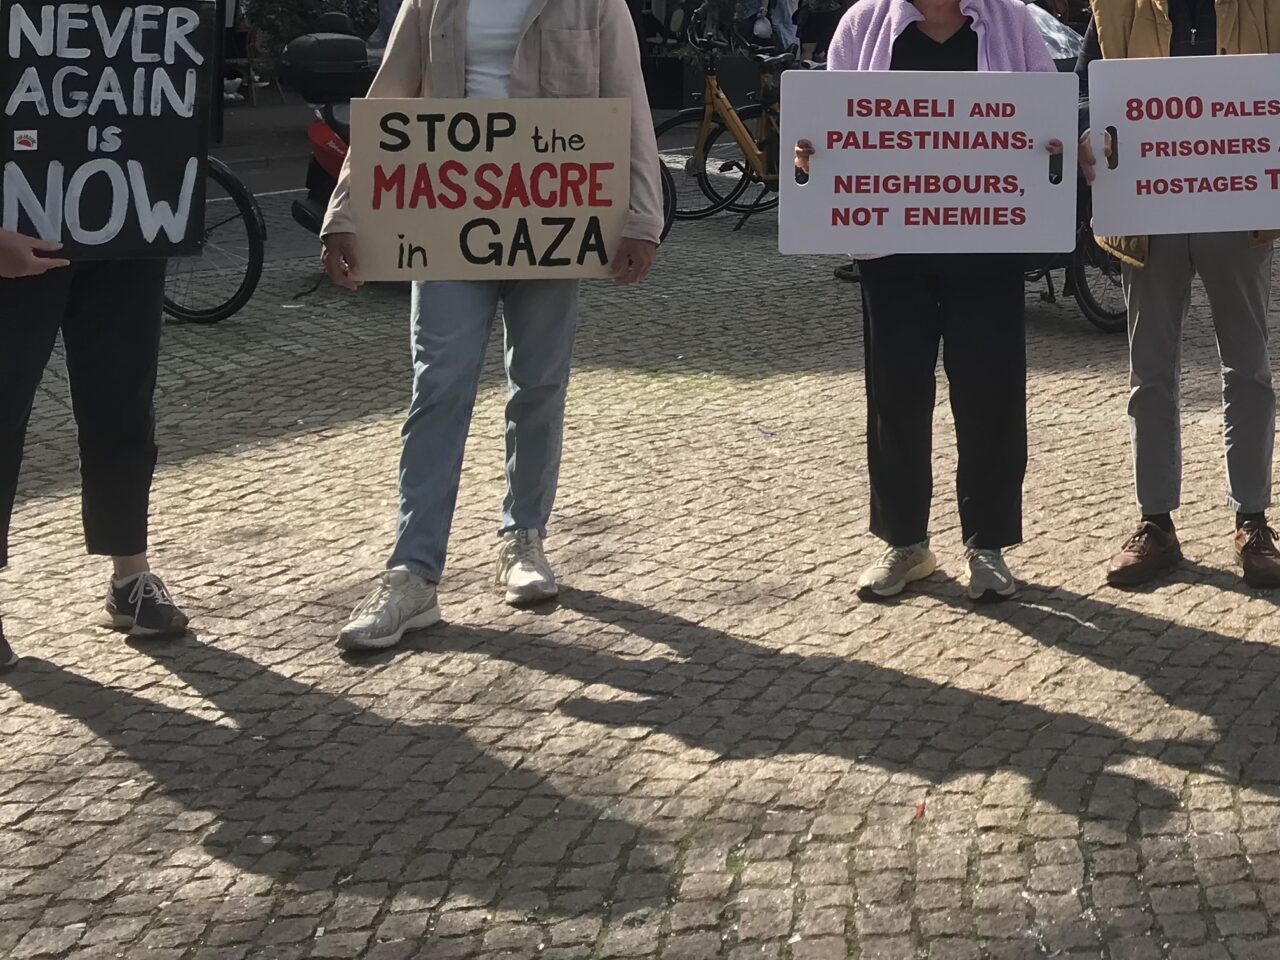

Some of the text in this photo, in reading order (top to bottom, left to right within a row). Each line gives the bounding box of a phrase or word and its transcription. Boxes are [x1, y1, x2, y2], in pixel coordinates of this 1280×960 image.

[8, 3, 205, 66] NEVER
[4, 66, 197, 118] AGAIN
[847, 98, 1017, 118] ISRAELI AND
[1125, 96, 1204, 121] 8000
[87, 126, 123, 152] IS
[379, 112, 586, 153] STOP the
[826, 130, 1034, 150] PALESTINIANS:
[1140, 137, 1271, 158] PRISONERS
[372, 159, 615, 211] MASSACRE
[833, 174, 1025, 197] NEIGHBOURS,
[1136, 175, 1258, 196] HOSTAGES
[2, 156, 199, 245] NOW
[831, 207, 1027, 226] NOT ENEMIES
[397, 215, 609, 269] in GAZA
